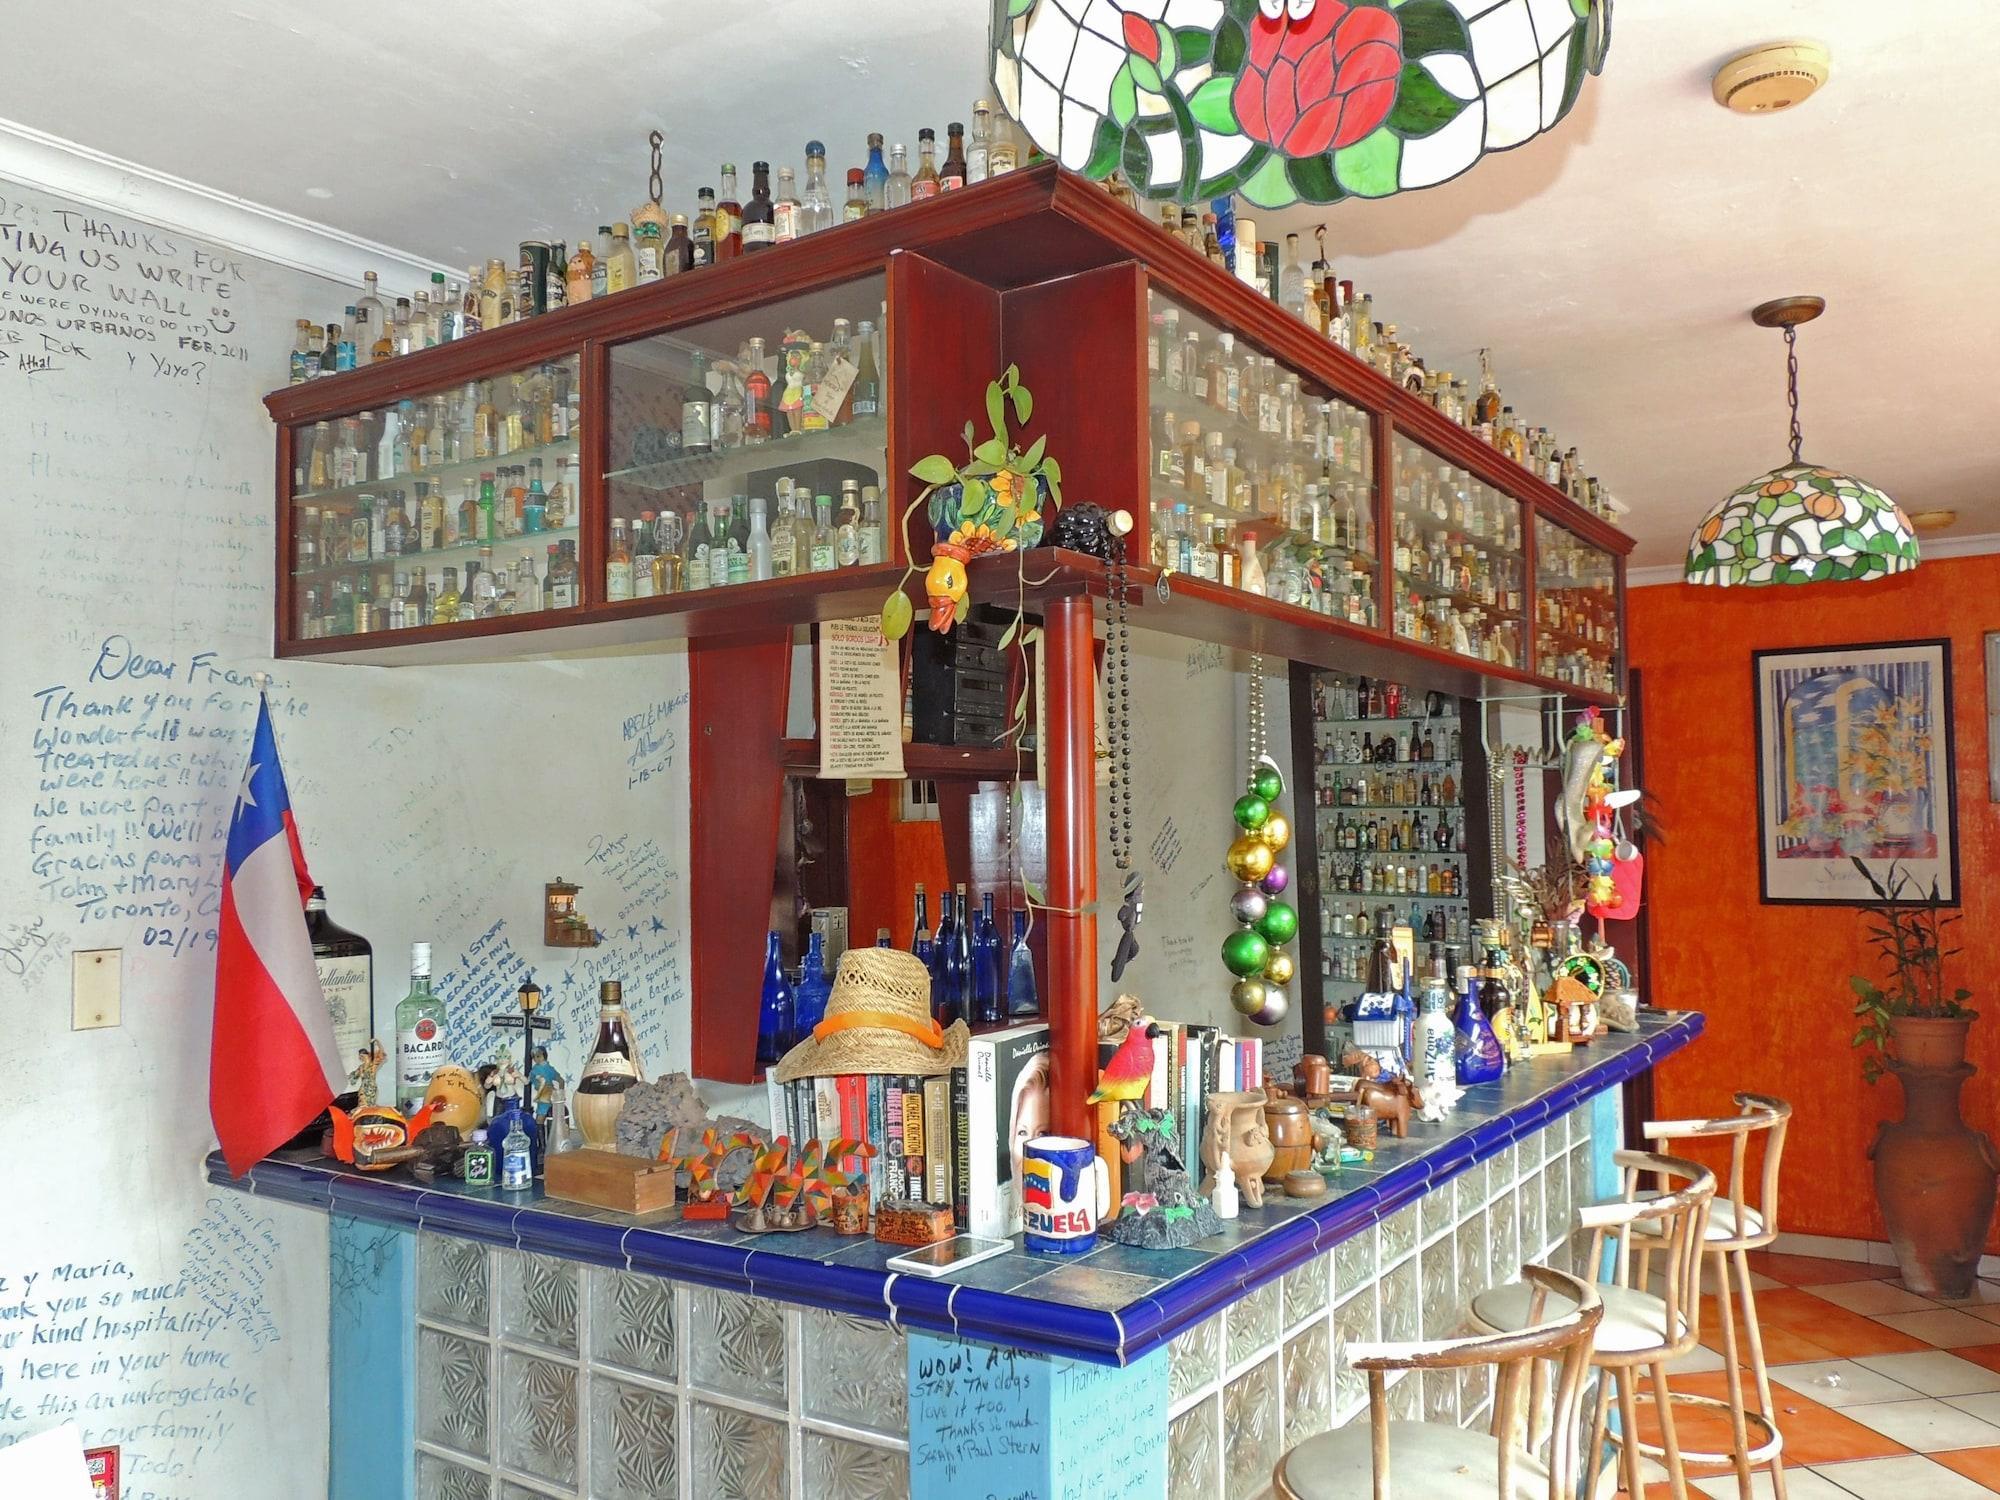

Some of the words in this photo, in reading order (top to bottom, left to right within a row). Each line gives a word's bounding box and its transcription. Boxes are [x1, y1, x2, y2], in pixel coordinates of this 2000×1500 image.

[53, 210, 177, 257] THANKS
[0, 223, 67, 263] TING
[80, 249, 121, 273] US
[137, 262, 232, 300] WRITE
[1, 256, 92, 293] YOUR
[108, 284, 192, 317] WALL
[20, 293, 71, 311] WERE
[79, 303, 130, 322] DYING
[56, 319, 157, 342] URBANOS
[89, 635, 178, 683] Dear
[33, 685, 132, 723] Thank
[140, 691, 192, 723] you
[34, 746, 138, 773] treated
[151, 753, 182, 770] us
[40, 770, 104, 792] were
[111, 769, 168, 790] here
[79, 796, 137, 817] were
[144, 796, 203, 827] part
[32, 851, 137, 877] Gracias
[75, 896, 192, 925] Toronto,
[319, 967, 366, 987] allantine's
[322, 985, 354, 994] INEST
[907, 1095, 921, 1124] MICHAEL
[908, 1124, 921, 1156] CRICHTON
[957, 1111, 969, 1144] DAVID
[888, 1159, 899, 1199] FRANC
[958, 1146, 969, 1197] BALDACCI
[910, 1176, 922, 1202] TIMEL
[1023, 1208, 1092, 1234] ZUELA
[52, 1258, 135, 1282] Maria,
[0, 1300, 38, 1321] ank
[47, 1293, 88, 1322] you
[99, 1289, 123, 1309] so
[131, 1279, 190, 1302] much
[31, 1316, 88, 1345] kind
[20, 1357, 82, 1381] here
[90, 1351, 111, 1376] in
[119, 1350, 171, 1381] your
[180, 1344, 231, 1371] home
[919, 1348, 974, 1380] WOW!
[994, 1368, 1031, 1402] dogs
[37, 1393, 78, 1417] this
[84, 1391, 116, 1412] an
[920, 1399, 949, 1423] love
[954, 1397, 968, 1418] it
